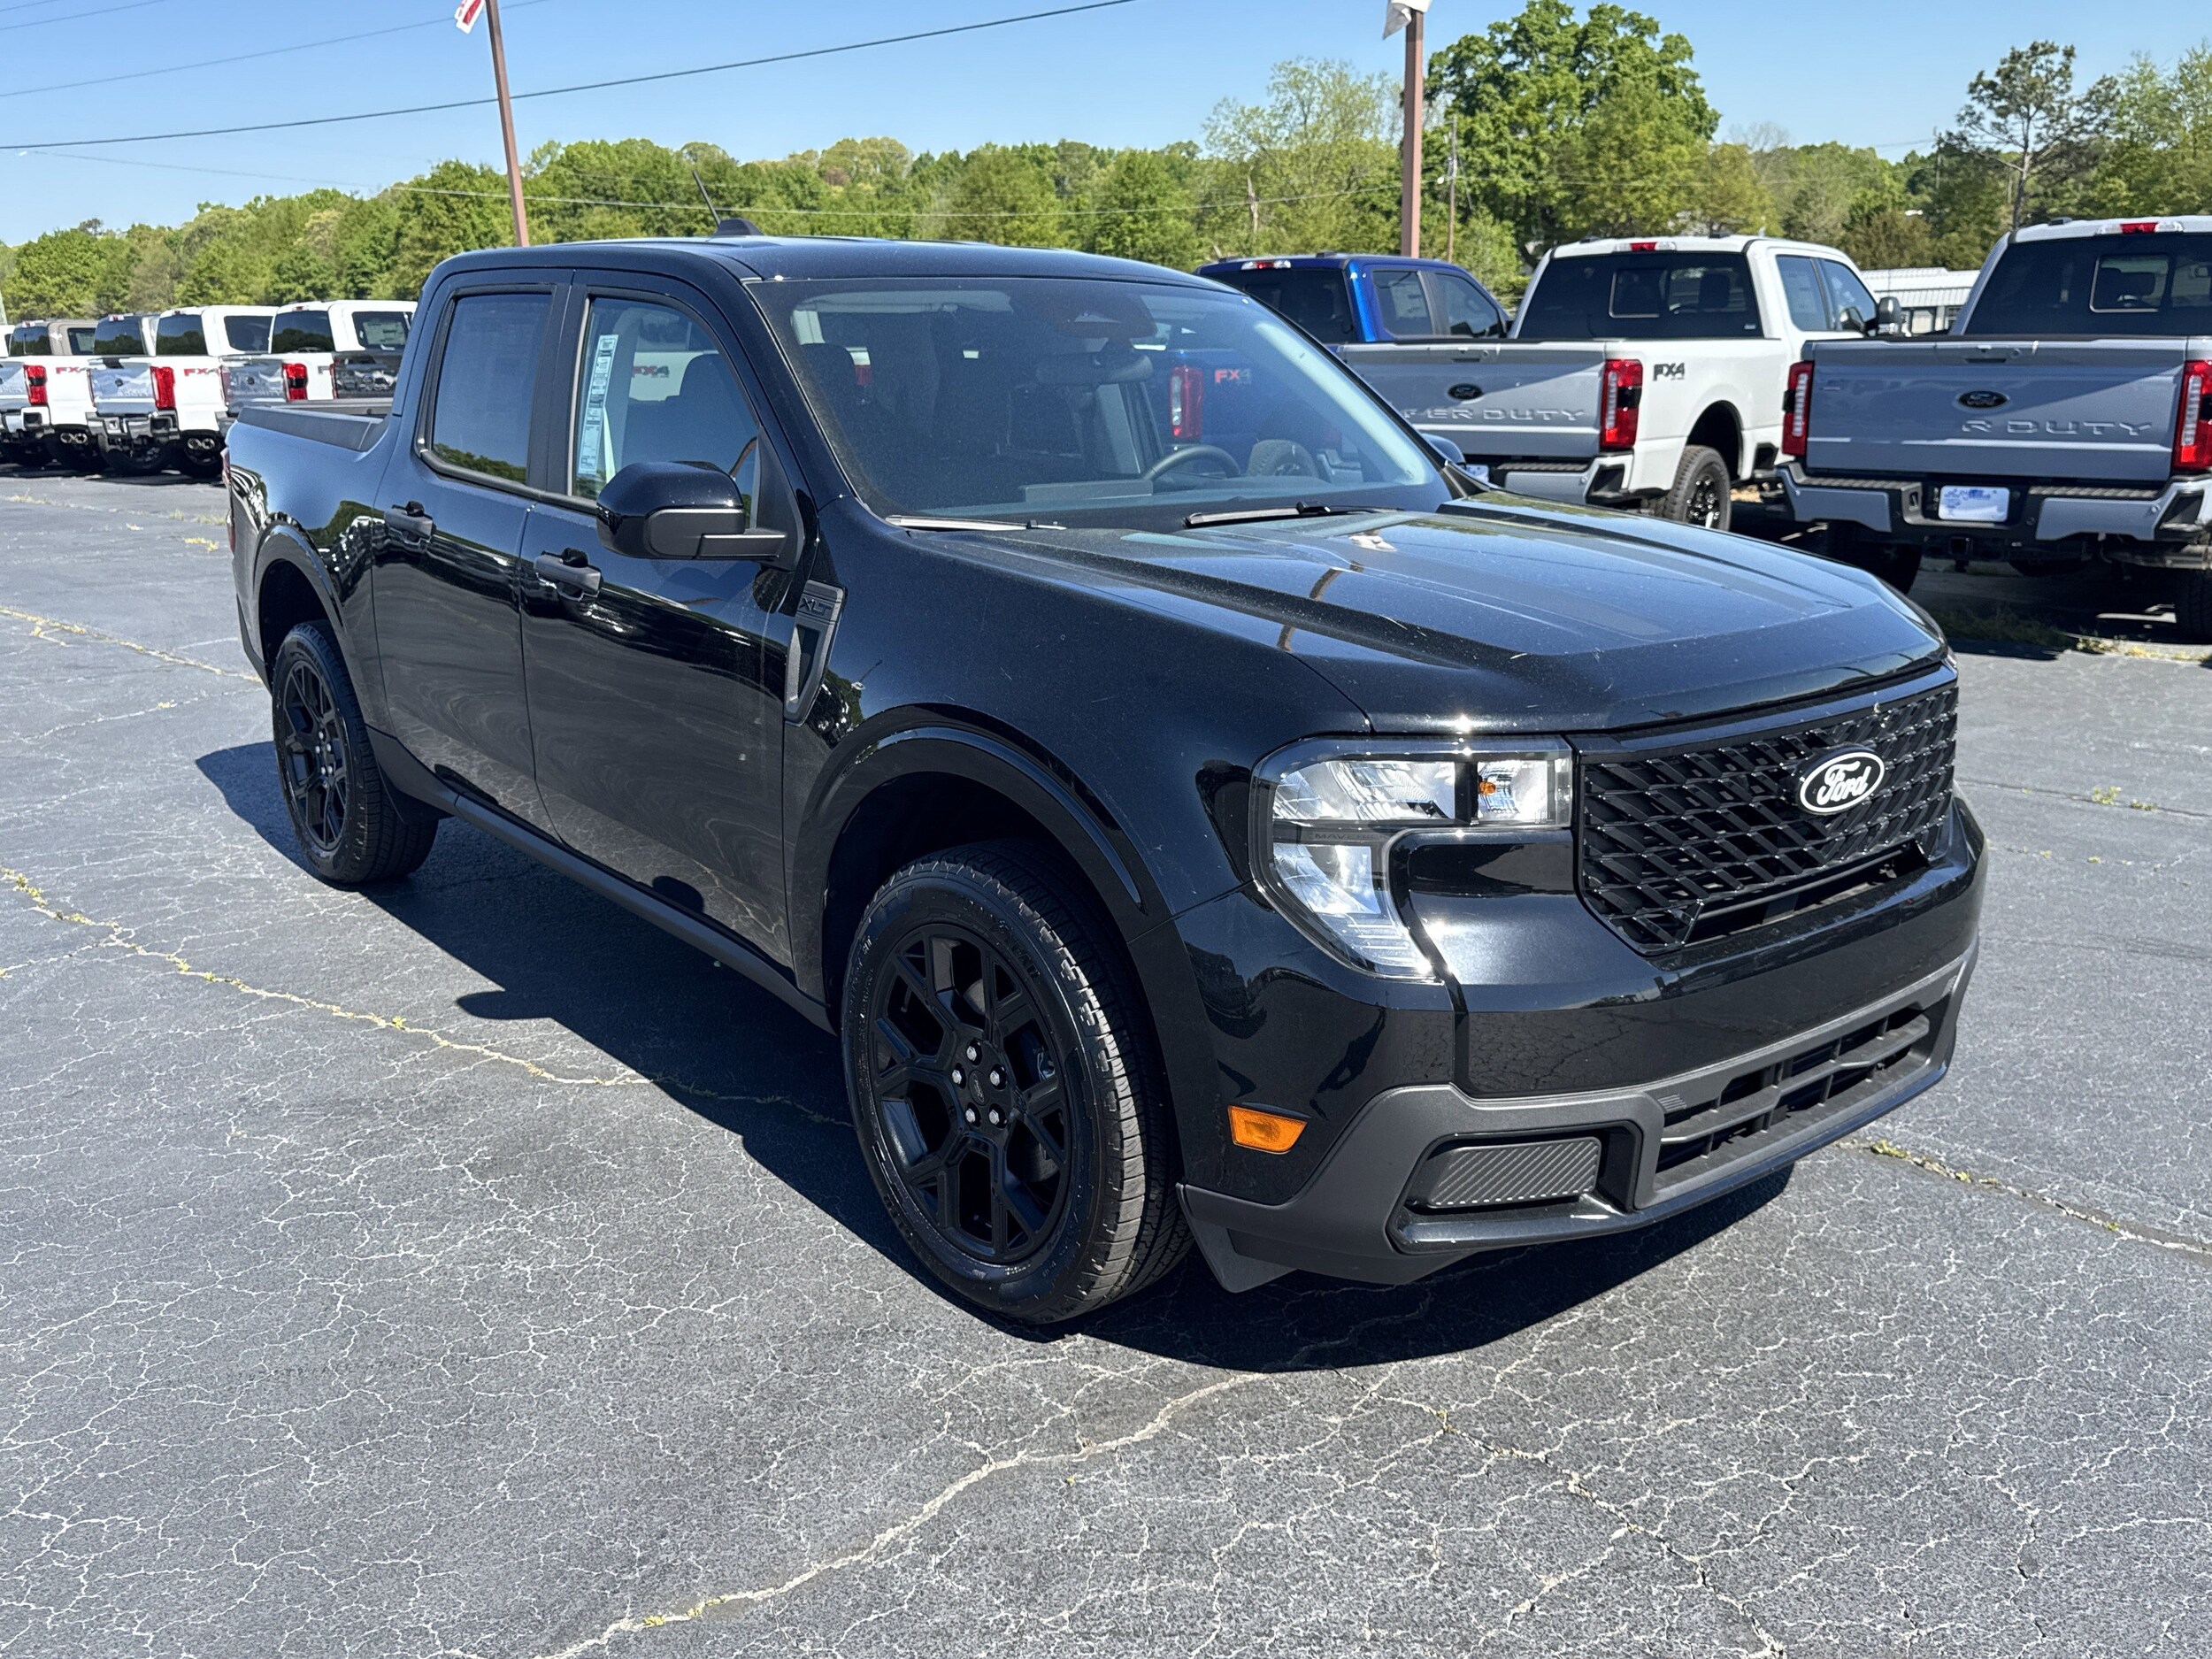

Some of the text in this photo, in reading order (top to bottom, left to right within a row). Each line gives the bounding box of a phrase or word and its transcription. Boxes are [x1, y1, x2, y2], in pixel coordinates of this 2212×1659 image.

[1215, 369, 1251, 382] FX4
[1653, 363, 1685, 380] FX4
[1483, 409, 1584, 421] DUTY
[2007, 420, 2152, 435] DUTY
[799, 596, 833, 616] XLT
[1816, 761, 1871, 805] Ford
